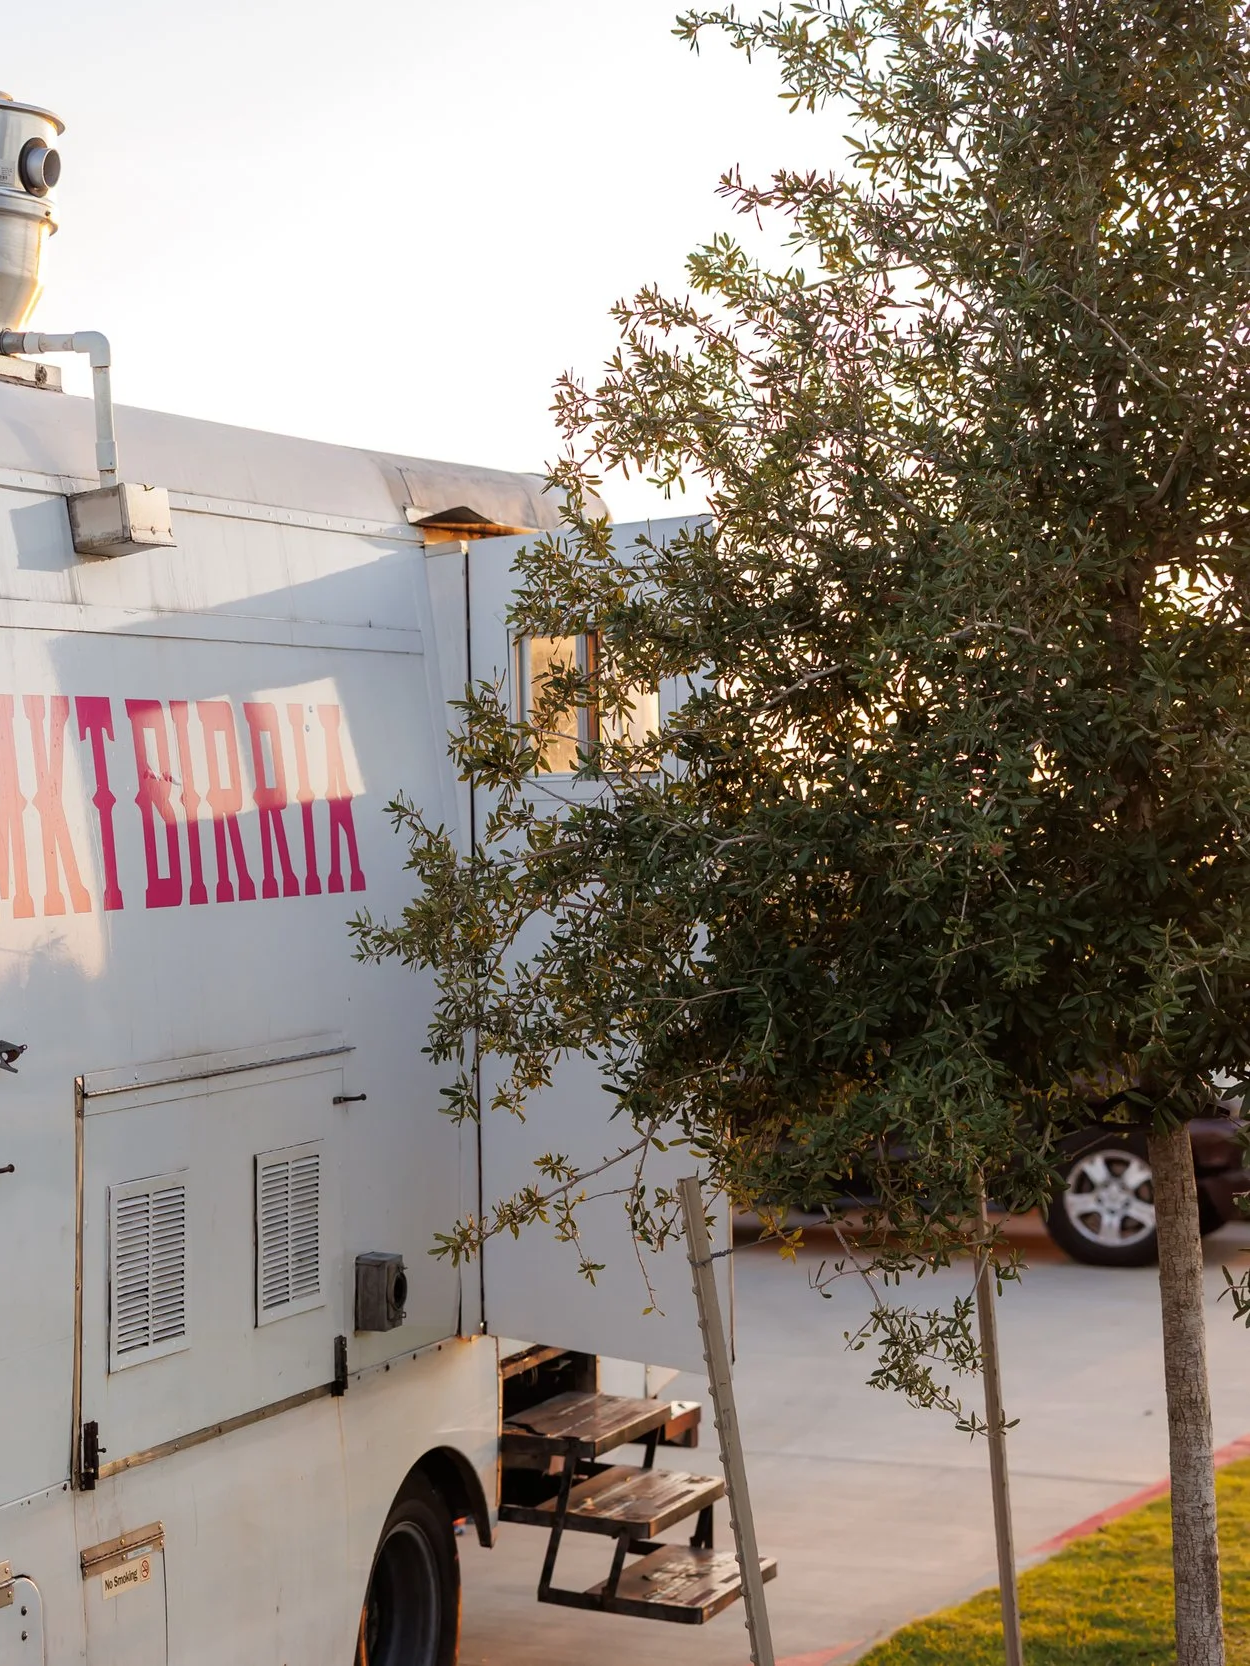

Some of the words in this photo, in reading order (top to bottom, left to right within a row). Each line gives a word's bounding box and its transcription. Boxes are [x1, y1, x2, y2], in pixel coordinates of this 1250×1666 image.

[124, 697, 367, 910] BIRRIA
[104, 1579, 113, 1591] No
[114, 1569, 138, 1587] Smoking
